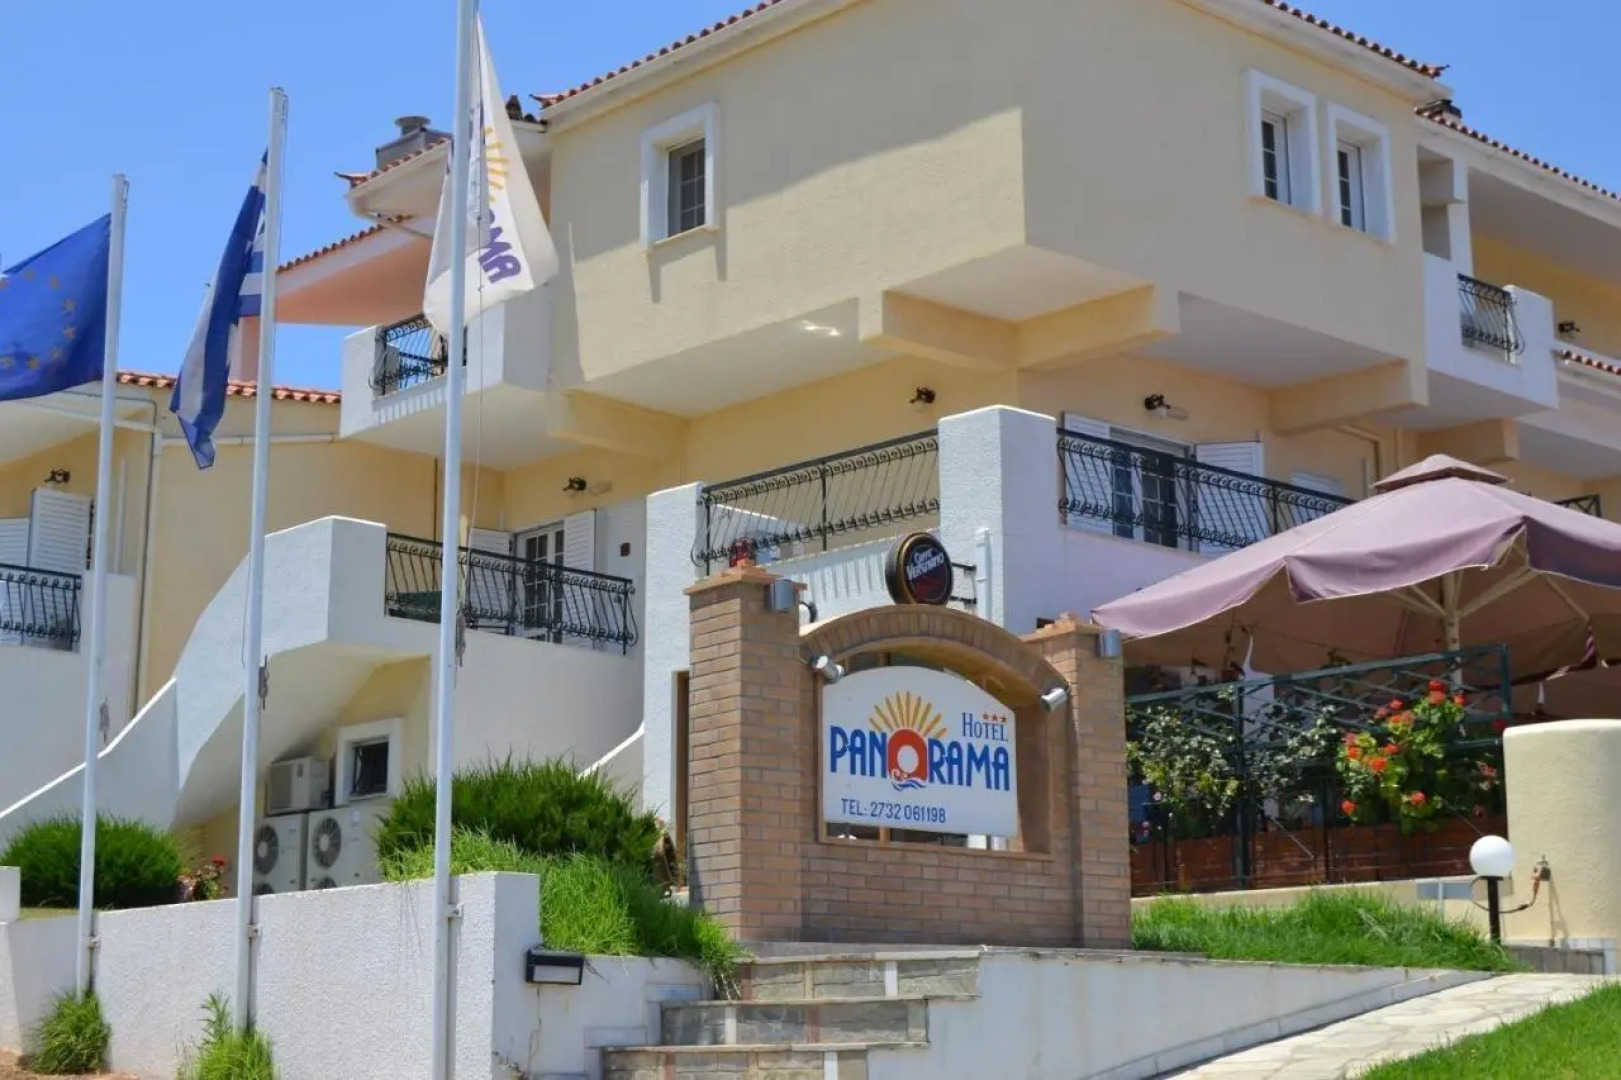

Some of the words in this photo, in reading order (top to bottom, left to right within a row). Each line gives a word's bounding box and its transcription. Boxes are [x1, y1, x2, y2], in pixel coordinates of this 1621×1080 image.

[962, 712, 1009, 742] HOTEL
[830, 725, 1010, 791] PANORAMA
[841, 798, 867, 816] TEL:
[870, 802, 901, 820] 2732
[904, 805, 947, 823] 061198
